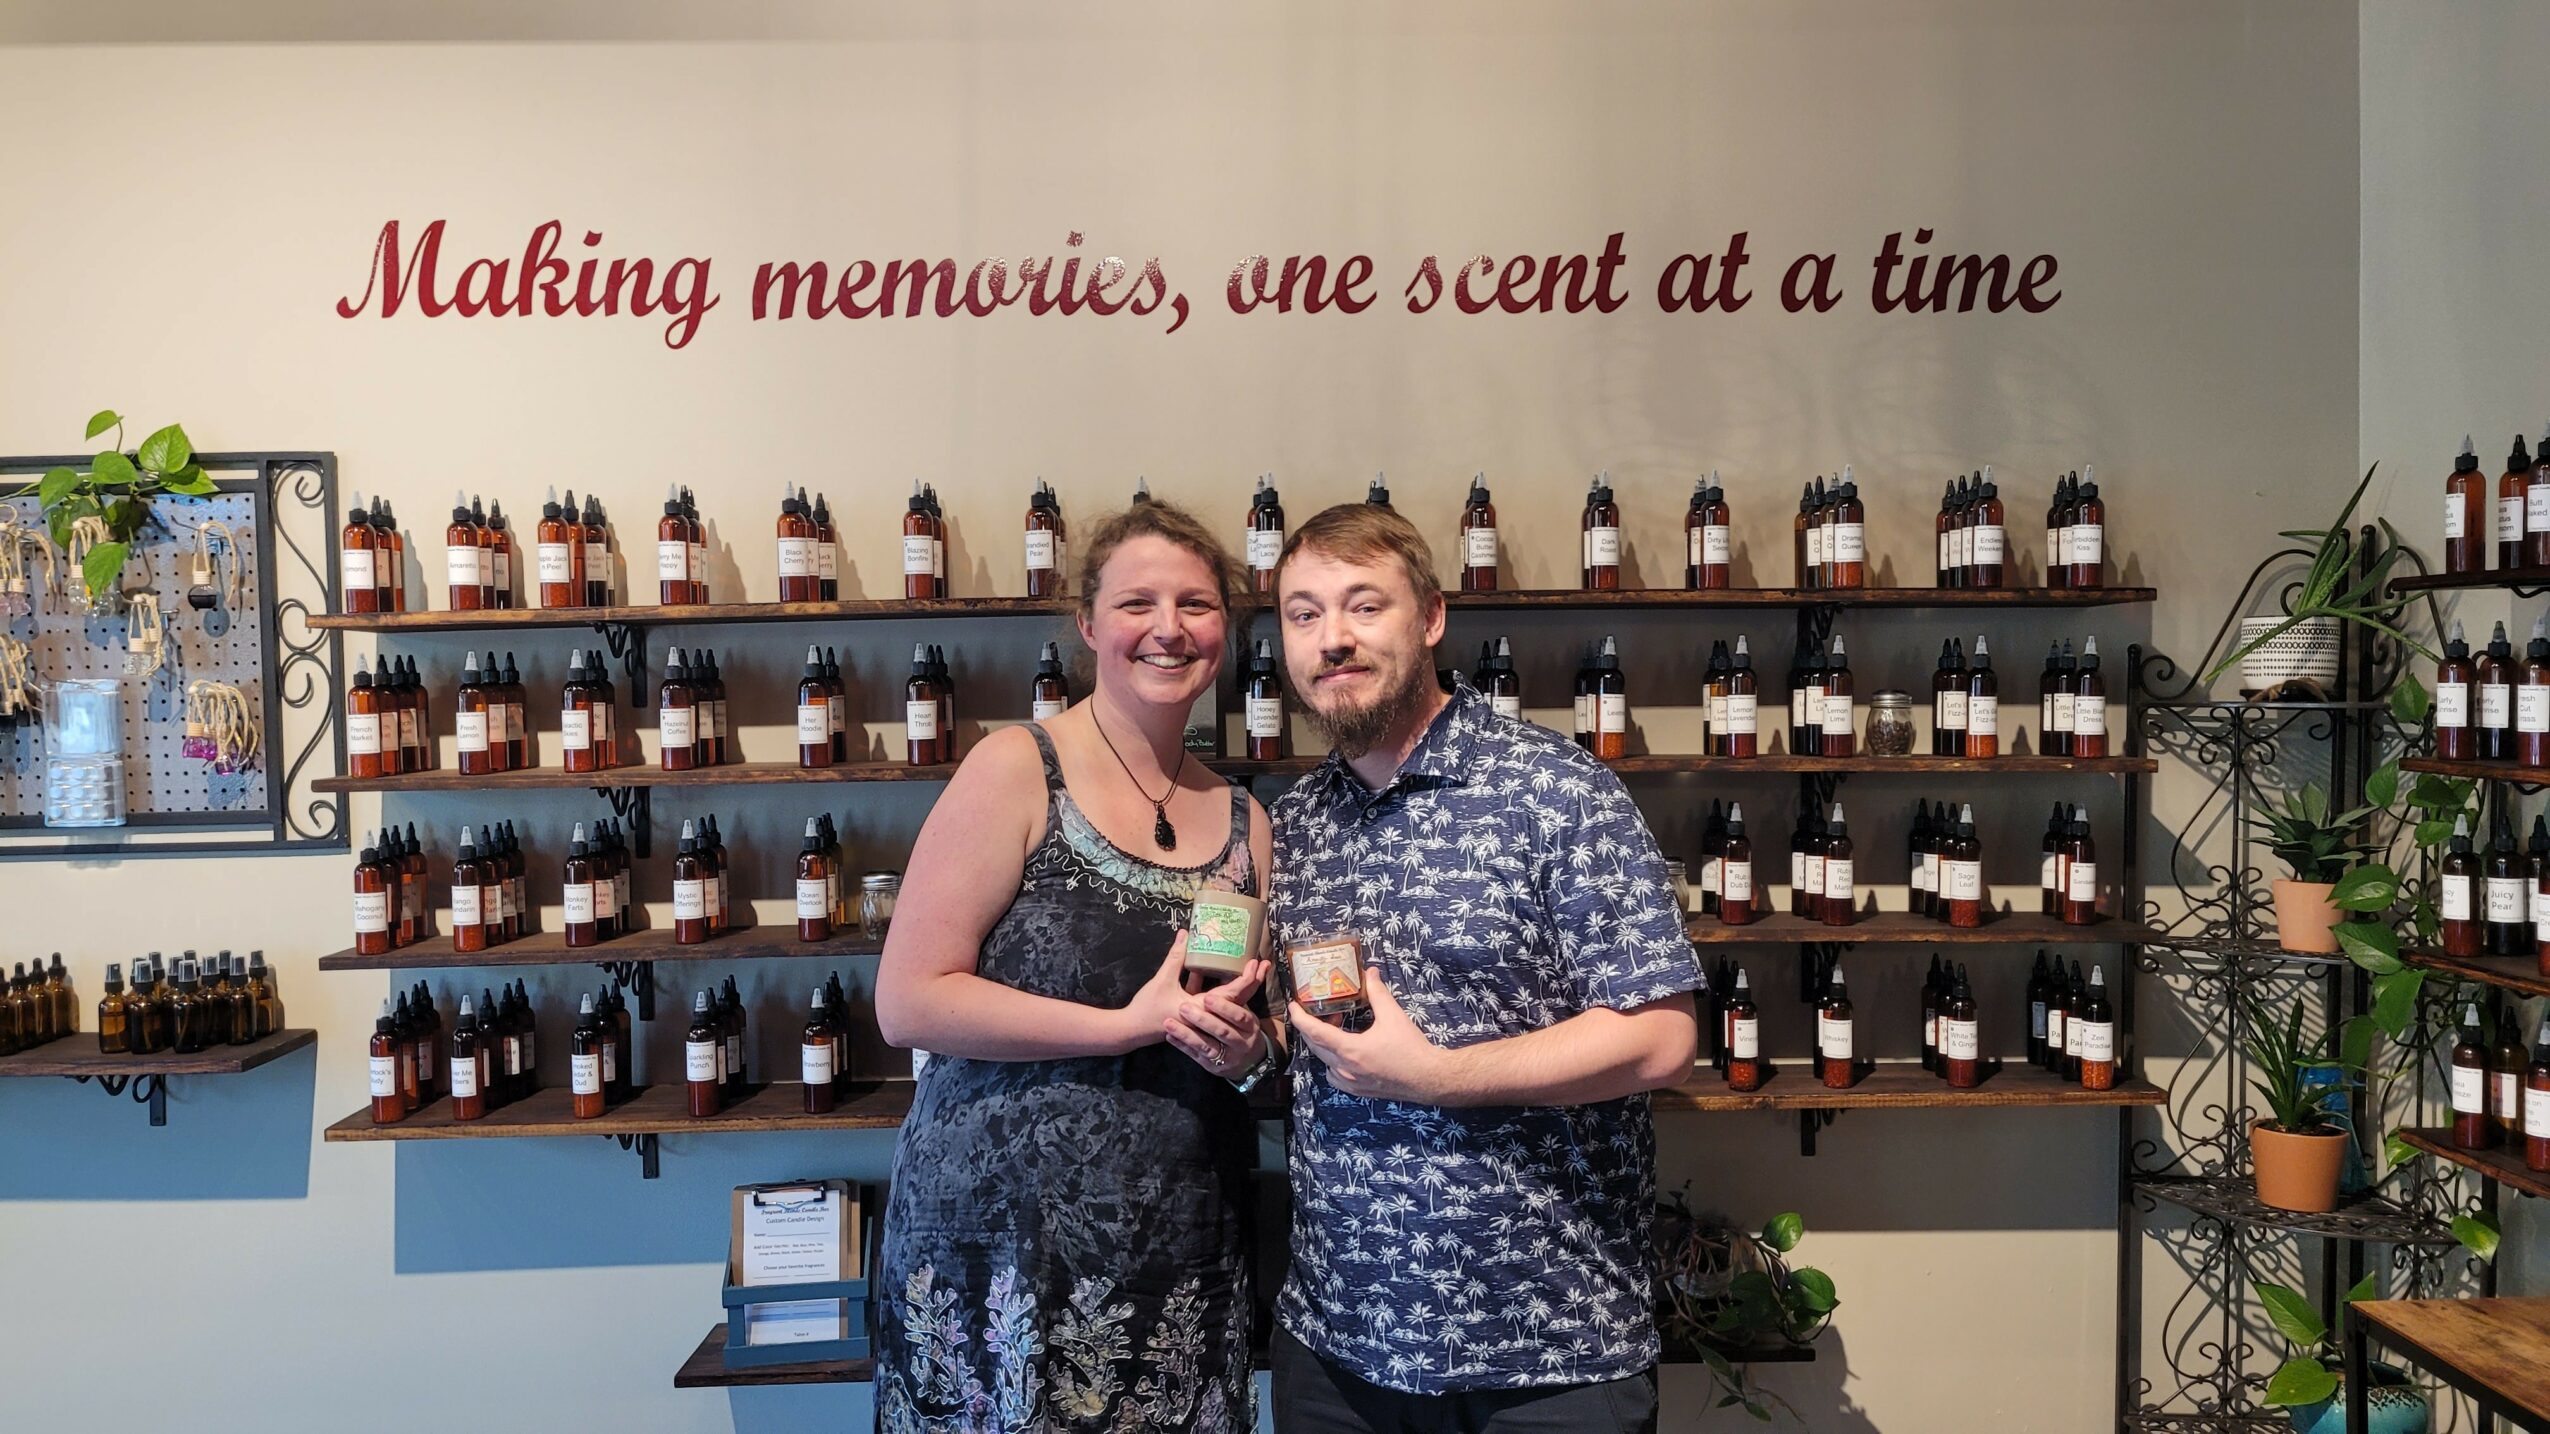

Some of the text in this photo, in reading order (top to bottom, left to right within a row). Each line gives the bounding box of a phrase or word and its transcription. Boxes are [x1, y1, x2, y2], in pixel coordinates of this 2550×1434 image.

[337, 219, 2062, 349] Making memories, one scent at a time
[2491, 890, 2514, 900] Juicy
[2492, 901, 2512, 910] Pear
